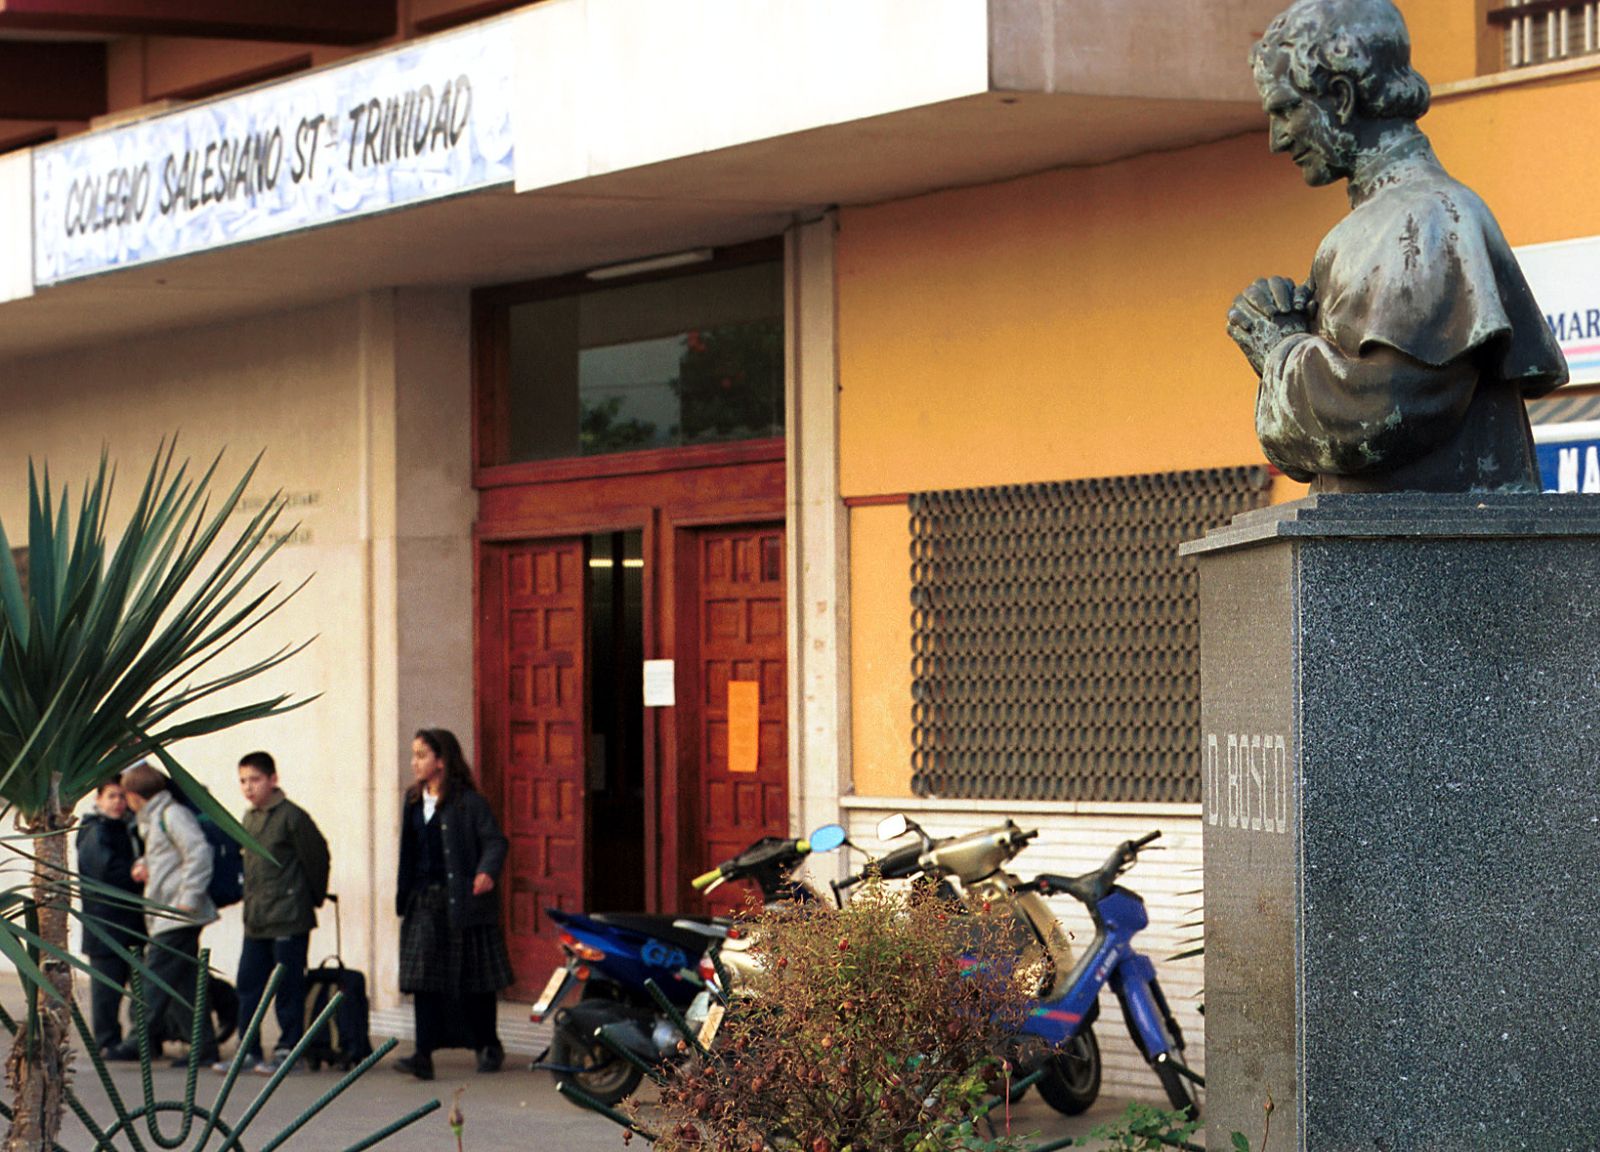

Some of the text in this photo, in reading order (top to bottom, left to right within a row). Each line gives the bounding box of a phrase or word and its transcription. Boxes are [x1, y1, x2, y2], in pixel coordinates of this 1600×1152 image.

[65, 161, 149, 238] COLEGIO
[160, 126, 283, 216] SALESIANO
[348, 73, 472, 172] TRINIDAD
[1228, 733, 1287, 834] BOSCO
